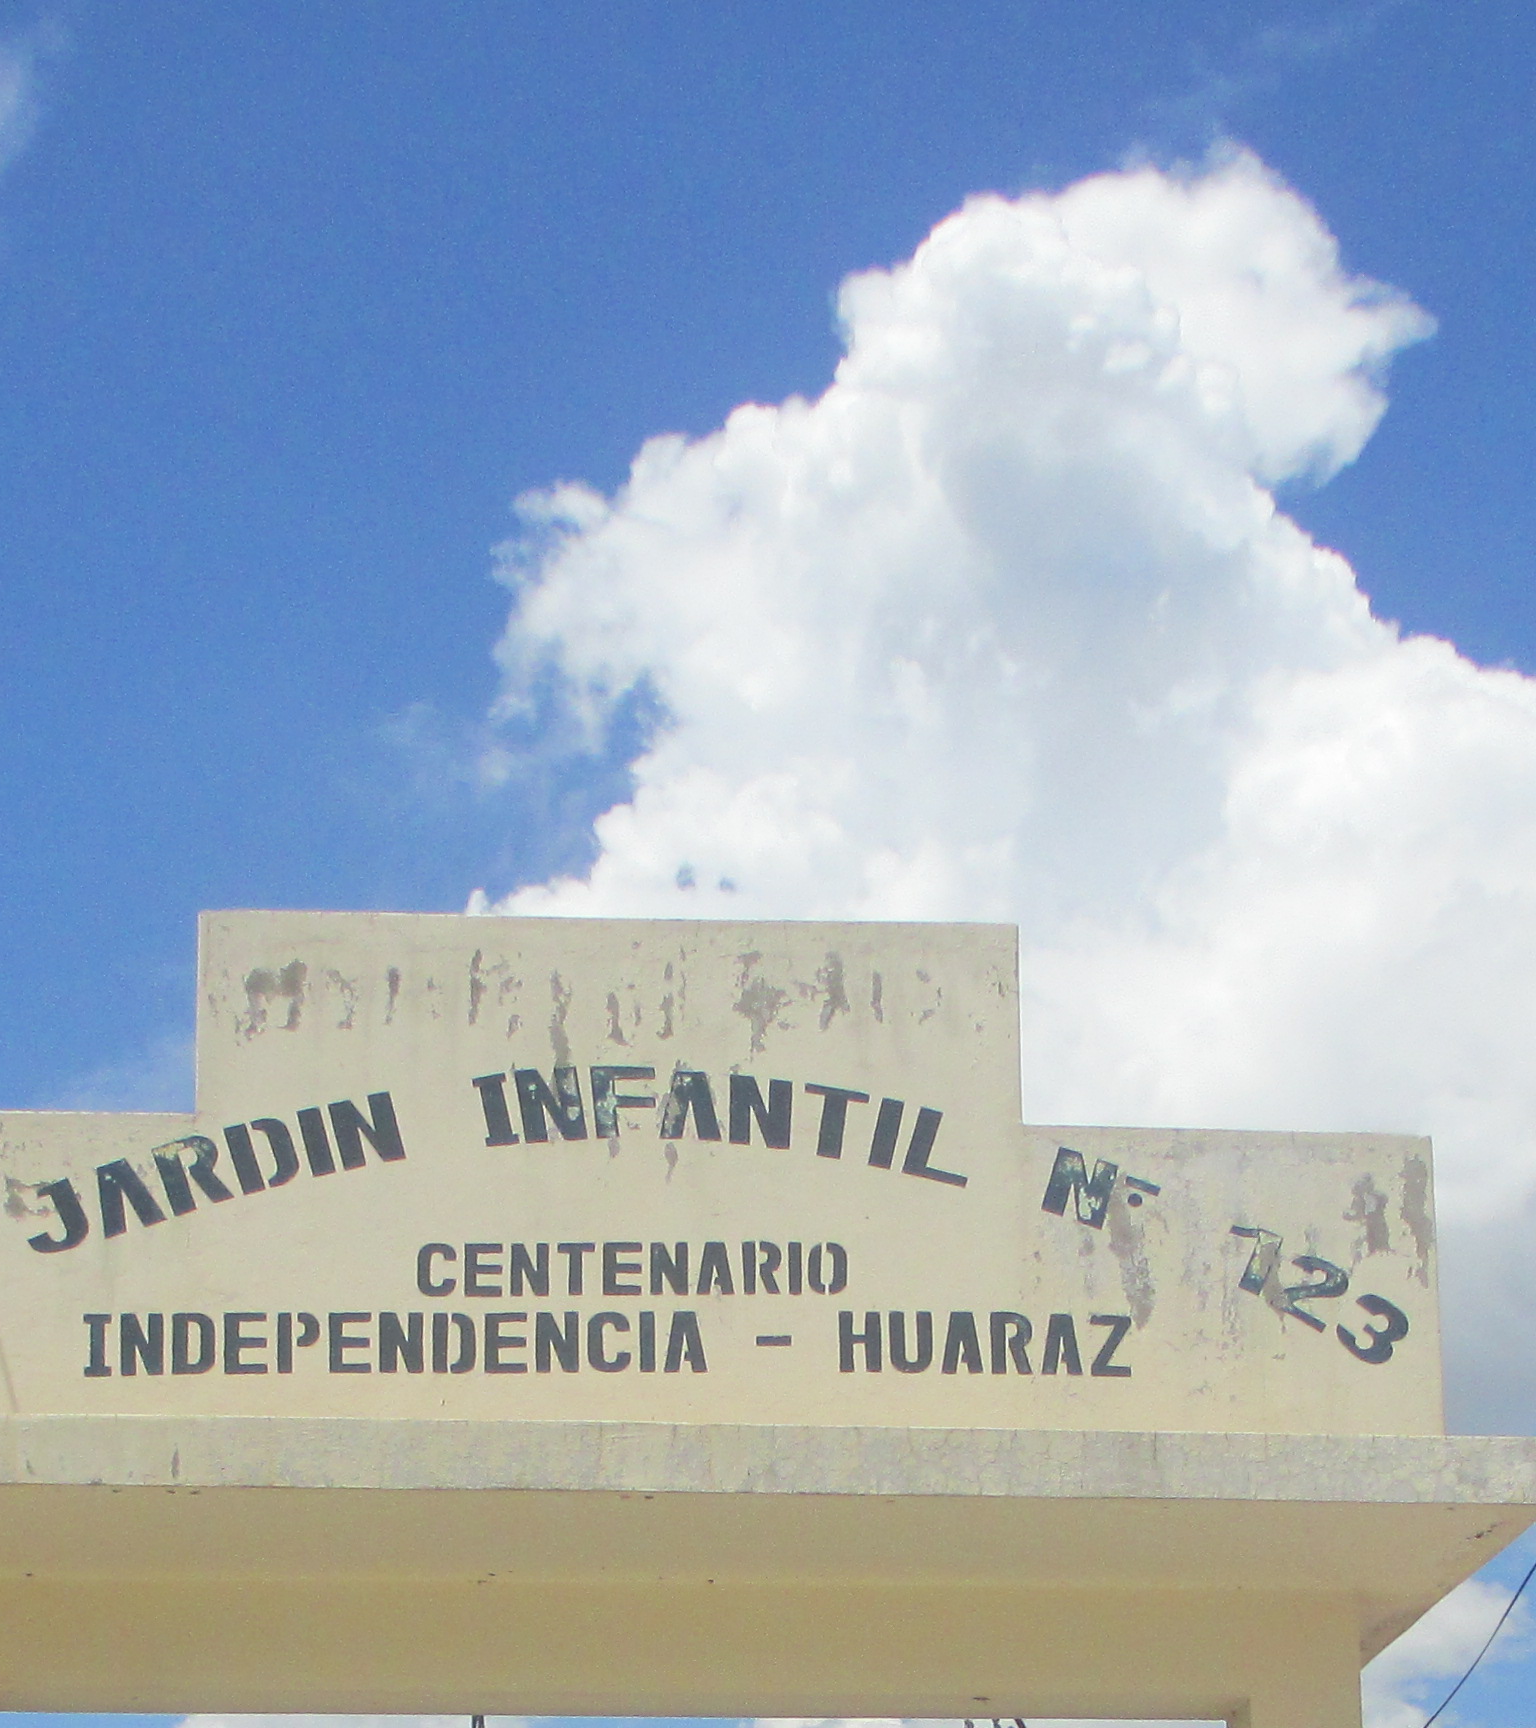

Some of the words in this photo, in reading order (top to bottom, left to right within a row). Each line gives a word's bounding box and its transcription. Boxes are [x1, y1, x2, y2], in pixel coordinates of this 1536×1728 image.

[26, 1091, 407, 1254] JARDIN
[471, 1065, 969, 1189] INFANTIL
[1228, 1224, 1410, 1365] 723
[416, 1240, 849, 1298] CENTENARIO
[82, 1309, 710, 1378] INDEPENDENCIA
[837, 1309, 1133, 1378] HUARAZ
